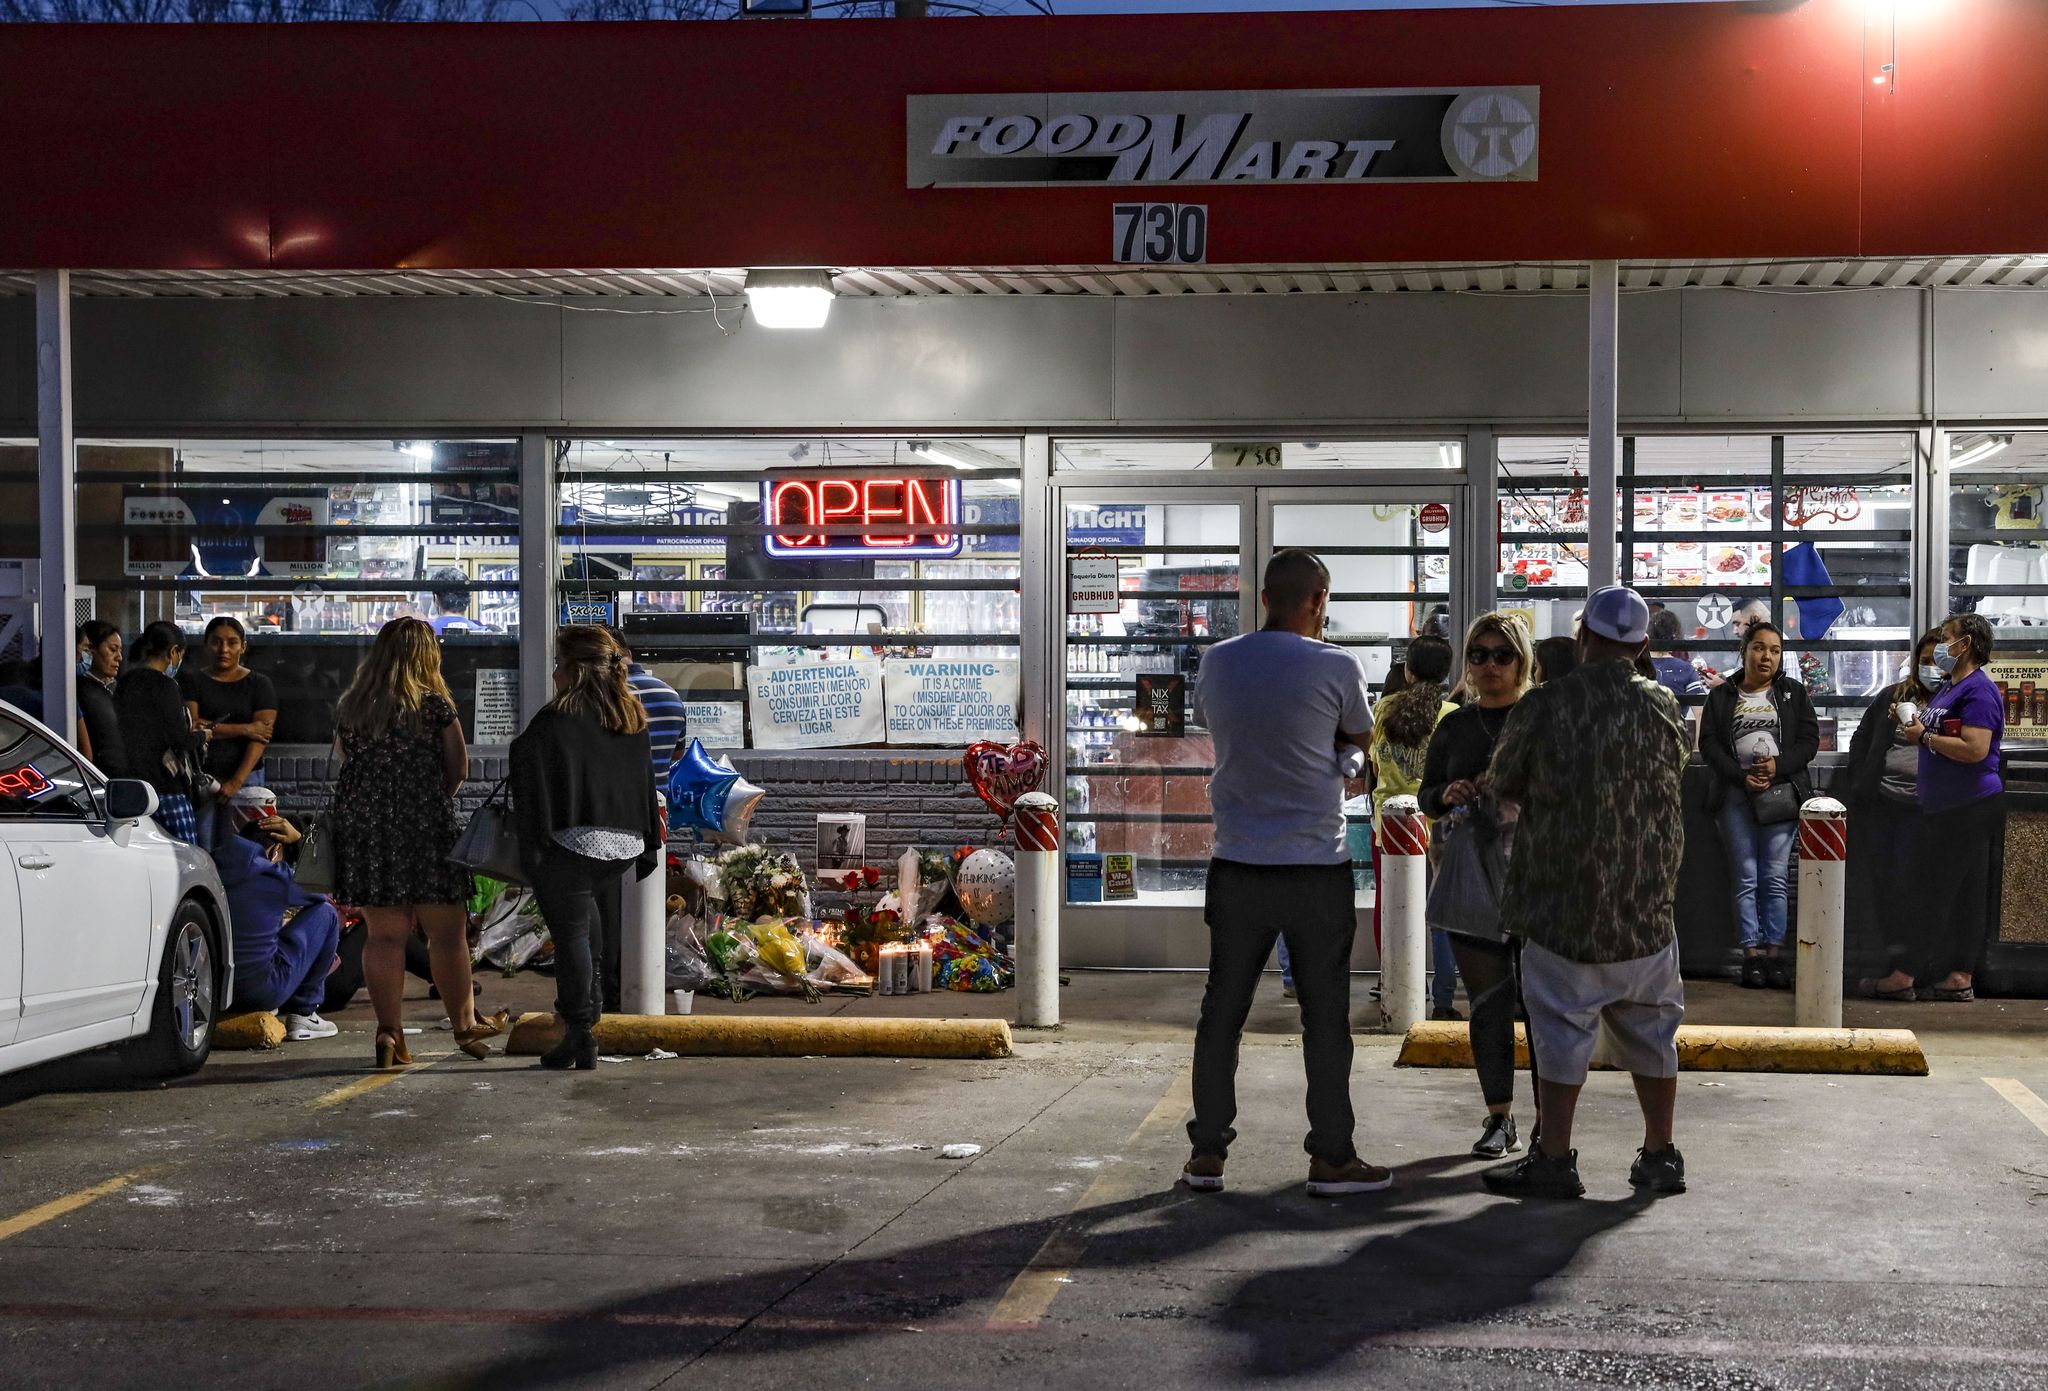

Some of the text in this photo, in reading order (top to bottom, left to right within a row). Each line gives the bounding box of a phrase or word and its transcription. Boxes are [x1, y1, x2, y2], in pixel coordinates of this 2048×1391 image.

[931, 113, 1397, 181] FOOD MART
[1114, 204, 1205, 263] 730
[773, 479, 951, 547] OPEN
[1072, 591, 1115, 601] GRUBHUB
[904, 664, 1000, 676] -WARNING-
[758, 678, 871, 698] ES UN CRIMEN (MENOR)
[922, 678, 982, 690] IT IS A CRIME
[1152, 688, 1169, 698] NIX
[768, 692, 862, 711] CONSUMIR LICOR O
[686, 706, 711, 716] UNDER
[773, 705, 861, 723] CERVEZA EN ESTE
[894, 705, 1011, 718] TO CONSUME LIQUOR OR
[1152, 704, 1169, 714] TAX
[799, 721, 836, 735] LUGAR.
[890, 718, 1016, 731] BEER ON THESE PREMISES.
[983, 754, 1006, 774] TE
[994, 769, 1036, 797] AMO
[1109, 878, 1131, 887] Card
[1111, 872, 1127, 880] We
